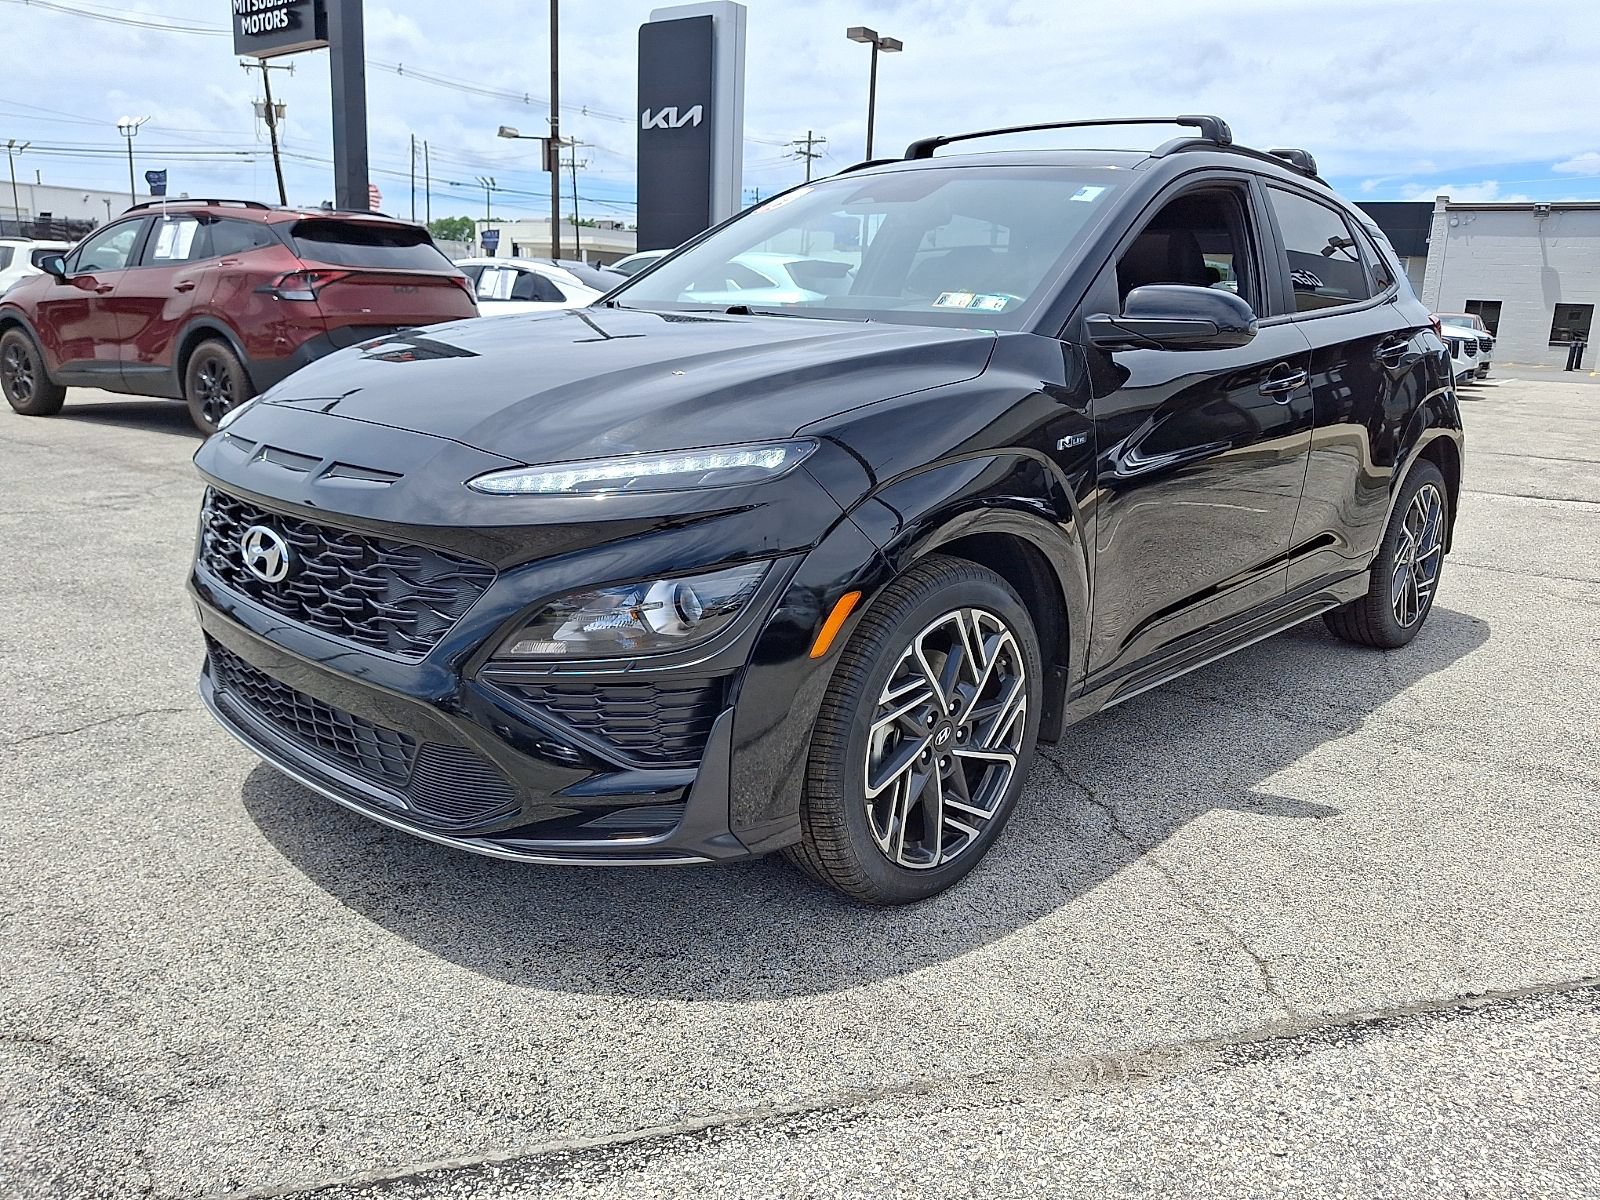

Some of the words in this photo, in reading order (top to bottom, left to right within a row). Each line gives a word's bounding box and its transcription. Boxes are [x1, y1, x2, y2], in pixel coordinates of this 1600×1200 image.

[233, 0, 296, 15] MITSU
[241, 8, 289, 35] MOTORS
[642, 105, 703, 129] KIA
